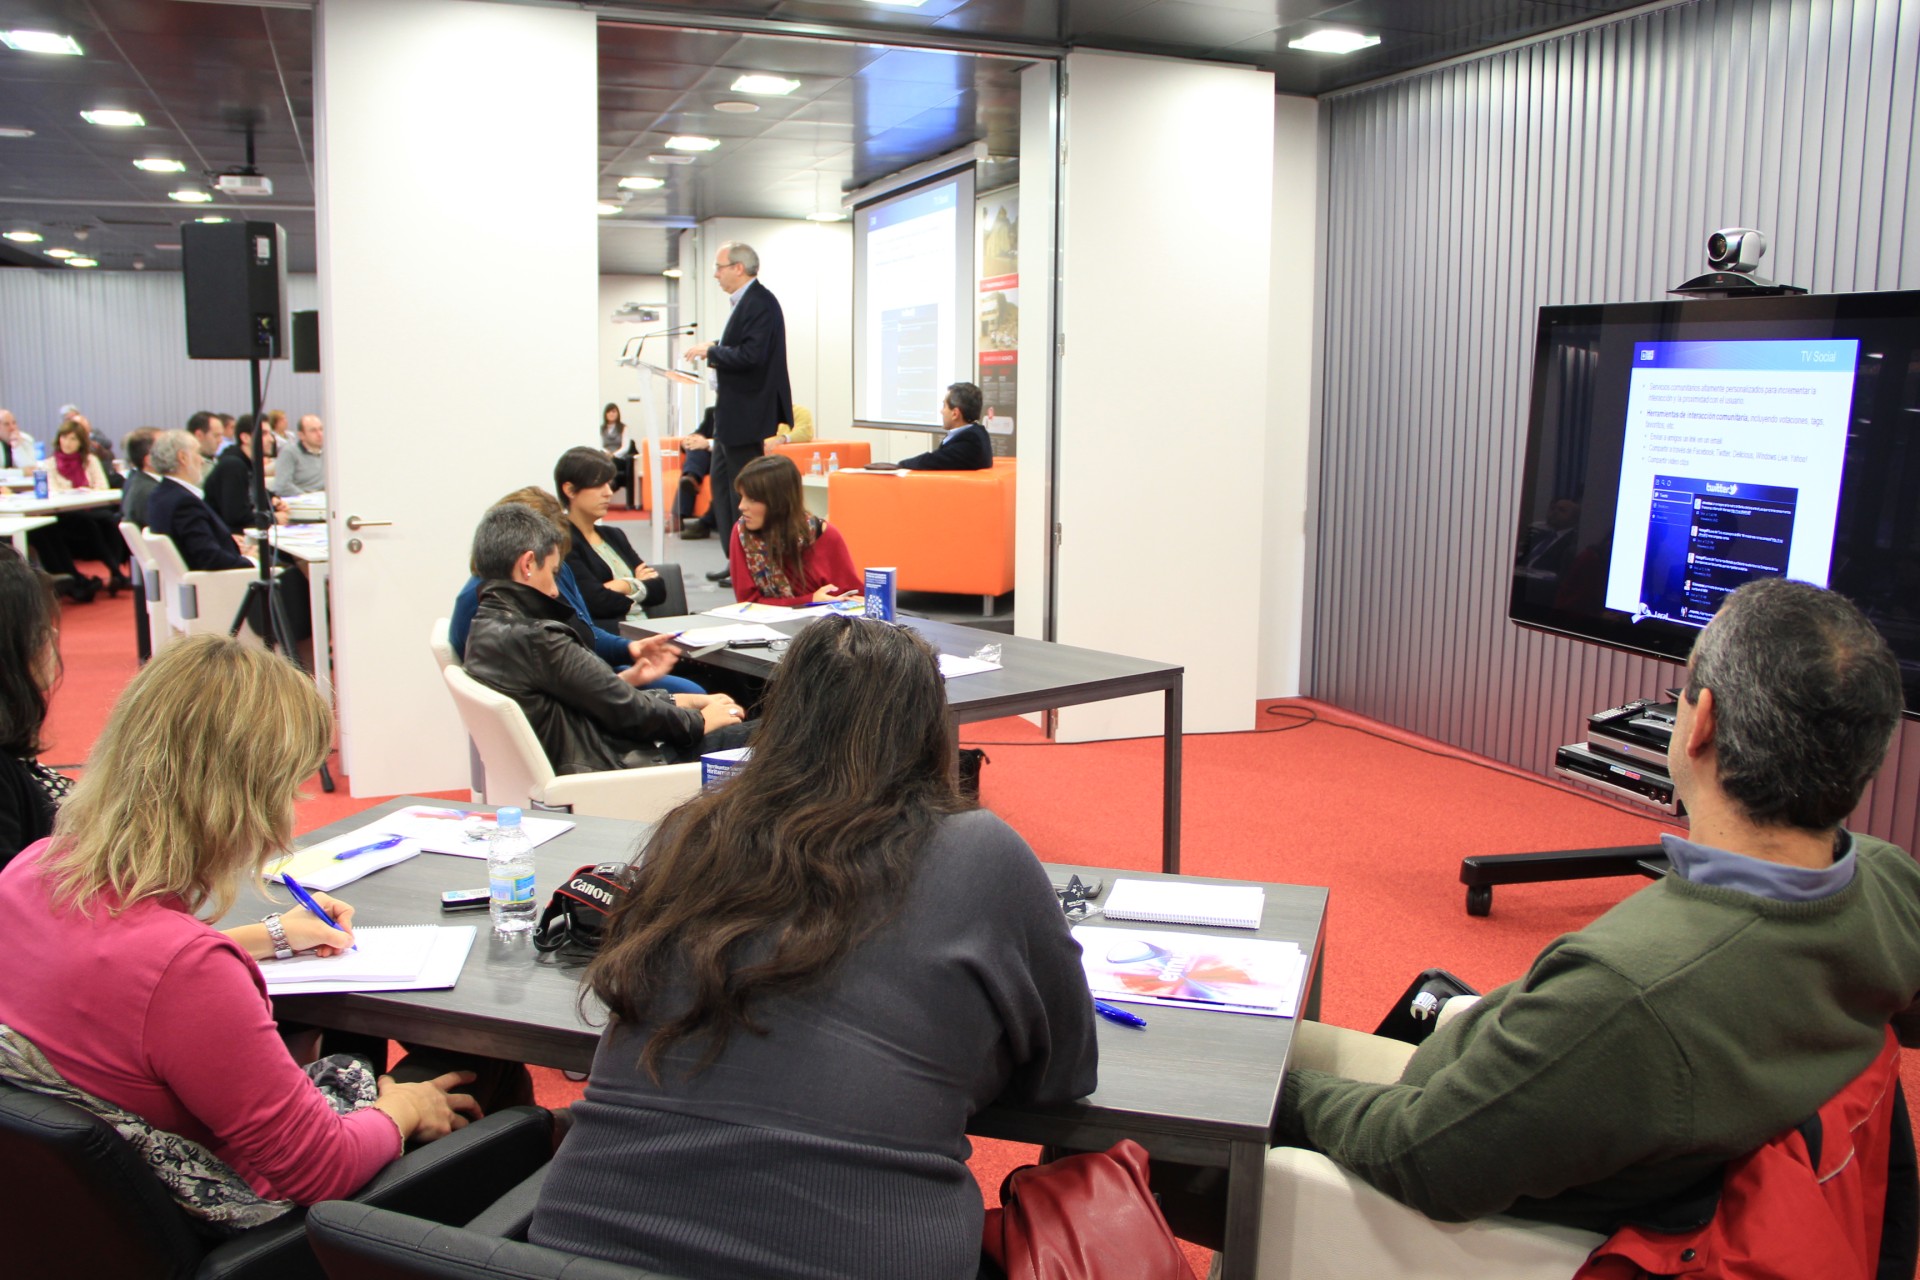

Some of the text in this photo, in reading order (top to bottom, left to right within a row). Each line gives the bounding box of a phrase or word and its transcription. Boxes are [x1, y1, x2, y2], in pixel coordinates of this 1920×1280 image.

[1801, 350, 1836, 363] TV Social
[1725, 385, 1764, 395] personalizados
[1765, 387, 1777, 395] para
[1778, 386, 1809, 394] incrementar
[1647, 408, 1679, 418] Herramientas
[1687, 410, 1715, 420] interacción
[1750, 414, 1778, 425] incluyendo
[1756, 451, 1777, 461] Windows
[1706, 482, 1731, 494] twitter
[570, 878, 613, 905] Canon
